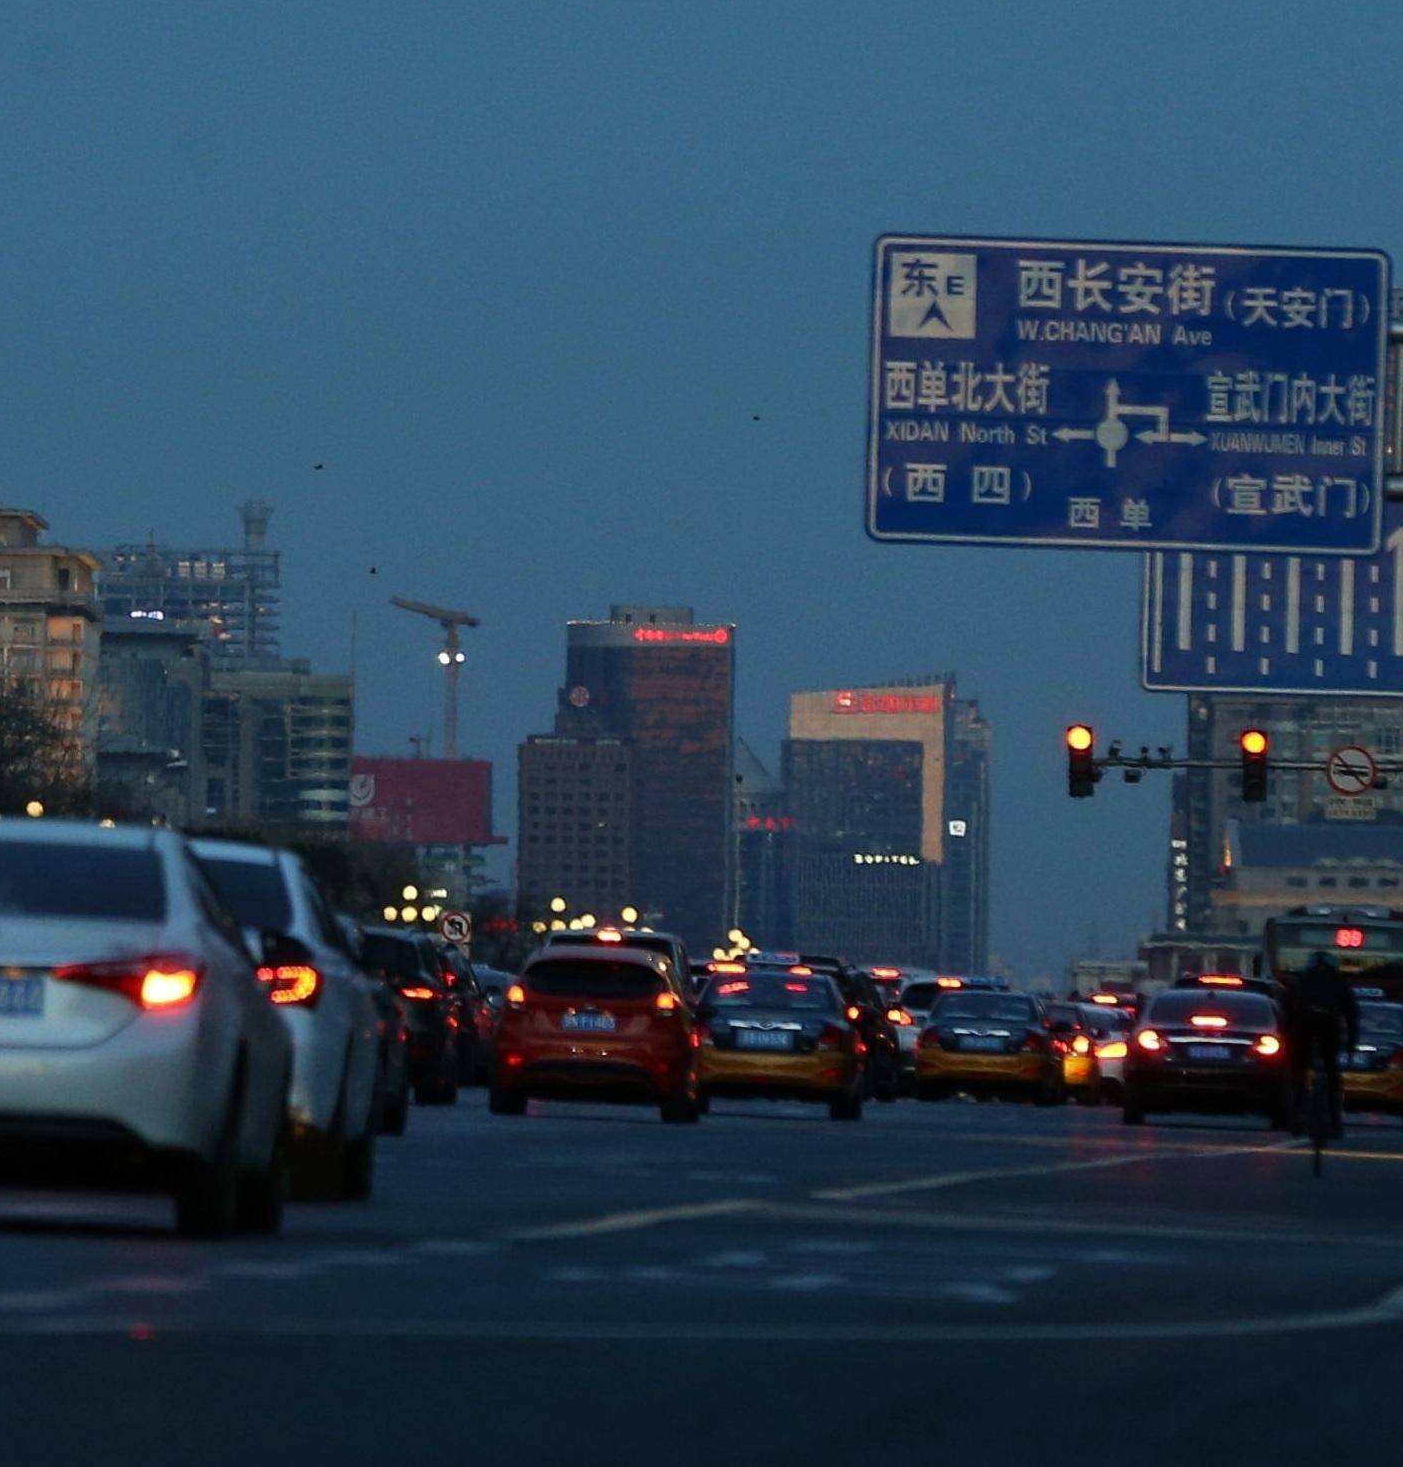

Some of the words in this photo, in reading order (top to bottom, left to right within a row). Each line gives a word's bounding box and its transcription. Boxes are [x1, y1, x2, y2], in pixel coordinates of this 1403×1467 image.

[901, 259, 938, 297] 东
[946, 276, 964, 296] E
[1018, 259, 1216, 316] 西长安街
[1224, 288, 1370, 330] (天安门)
[1174, 327, 1212, 347] Ave
[885, 361, 1050, 416] 西单北大街
[1206, 371, 1375, 426] 宣武门内大街
[886, 421, 949, 443] XIDAN
[961, 424, 1015, 445] North
[1027, 425, 1047, 445] St
[1211, 433, 1304, 455] XUANWUMEN
[1311, 435, 1345, 456] Inner
[1350, 437, 1366, 456] St
[882, 463, 1032, 503] (西四)
[1212, 475, 1371, 520] (宣武门)
[1068, 496, 1152, 532] 西单
